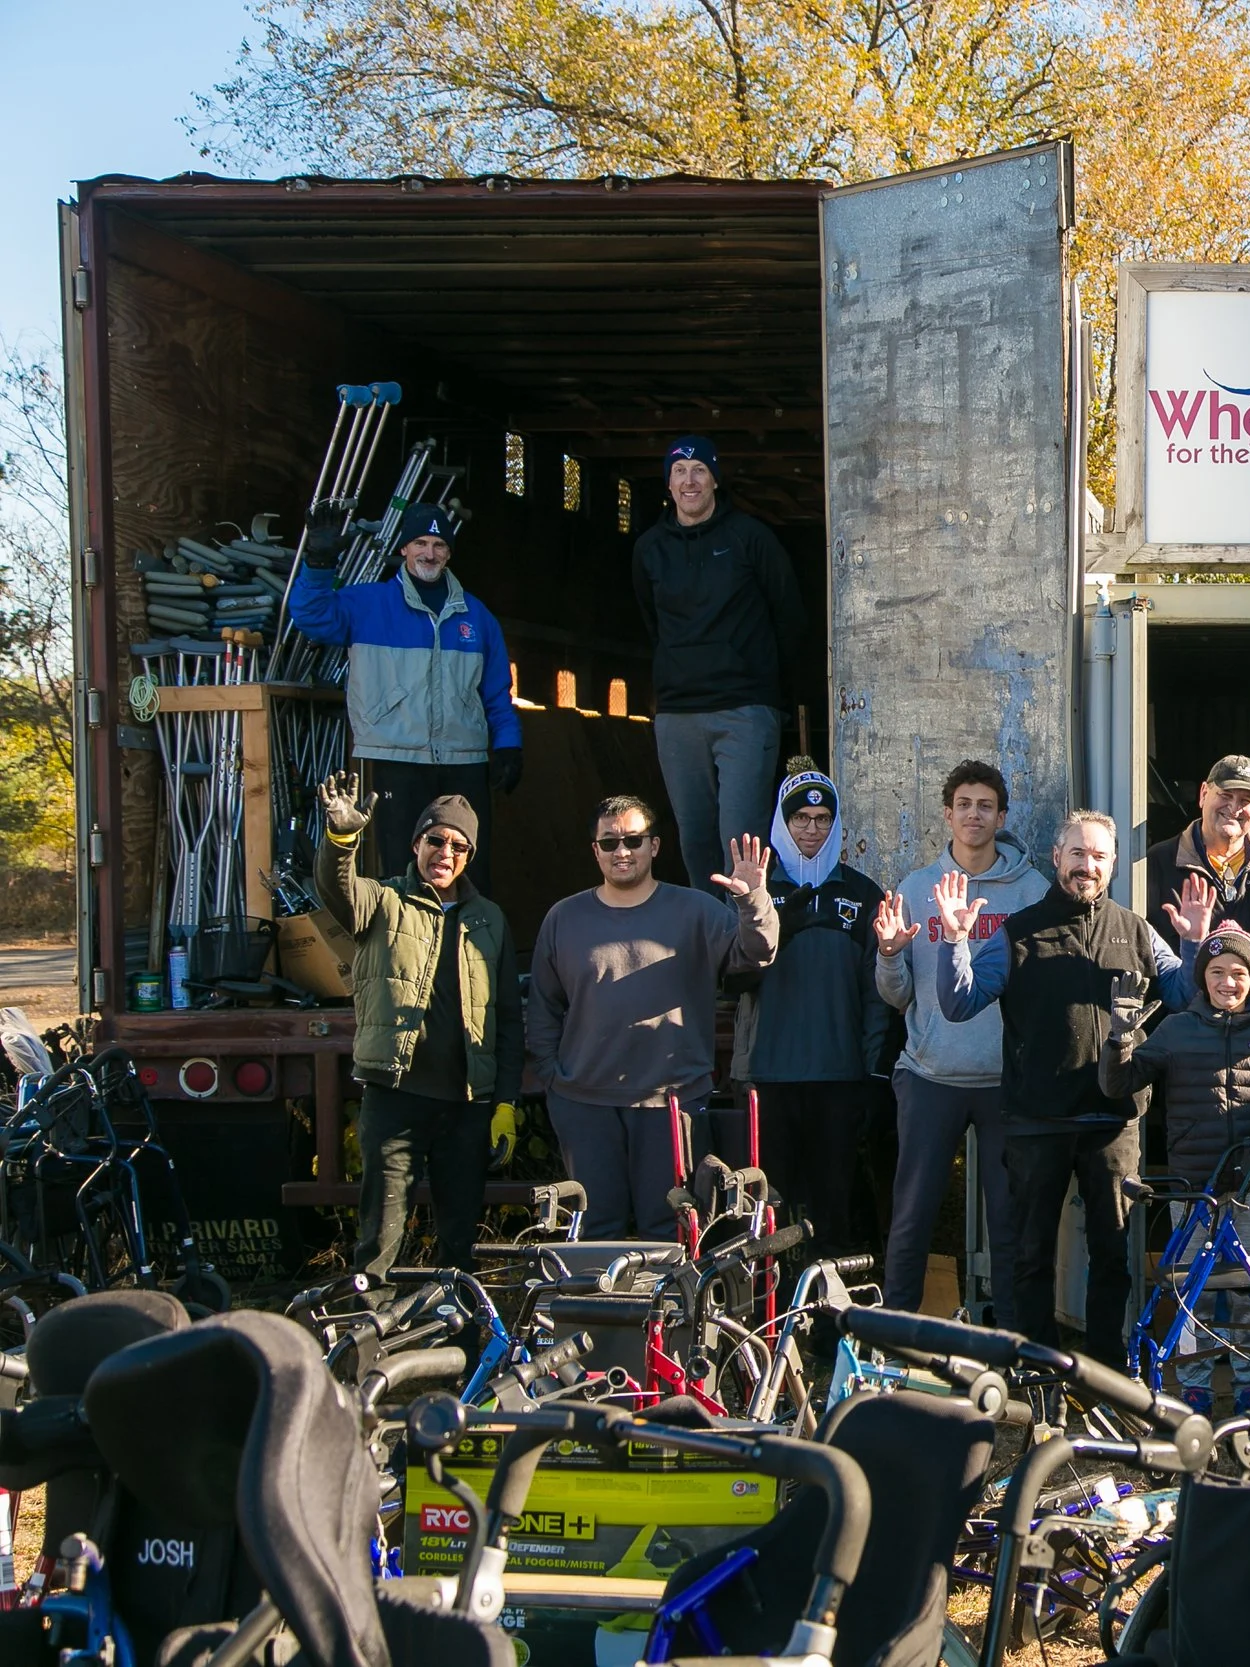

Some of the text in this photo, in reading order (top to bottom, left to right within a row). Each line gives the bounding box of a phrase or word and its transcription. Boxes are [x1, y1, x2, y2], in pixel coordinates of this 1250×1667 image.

[1166, 444, 1202, 464] for
[1210, 444, 1249, 464] the
[429, 519, 440, 534] A
[188, 1218, 280, 1240] RIVARD
[148, 1237, 283, 1255] TRAER SALES
[425, 1508, 470, 1529] RYO
[138, 1538, 194, 1568] JOSH
[419, 1551, 465, 1563] CORDLES
[509, 1541, 566, 1555] DEFENDER
